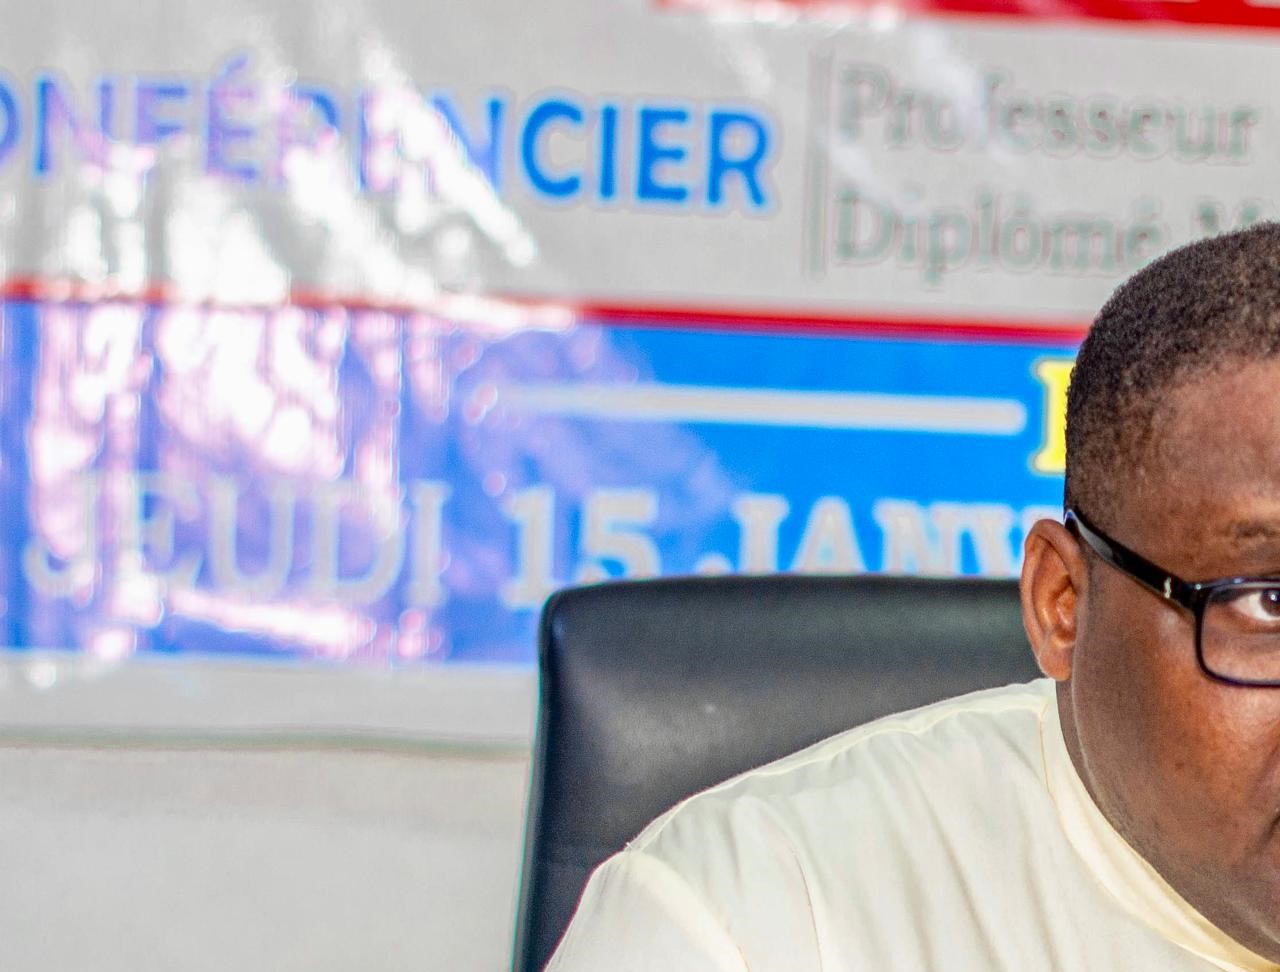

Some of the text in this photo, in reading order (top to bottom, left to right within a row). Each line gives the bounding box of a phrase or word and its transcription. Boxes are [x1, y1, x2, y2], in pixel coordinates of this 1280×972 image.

[838, 64, 1256, 160] Professeur
[24, 468, 452, 608] JEUDI
[506, 484, 662, 608] 15
